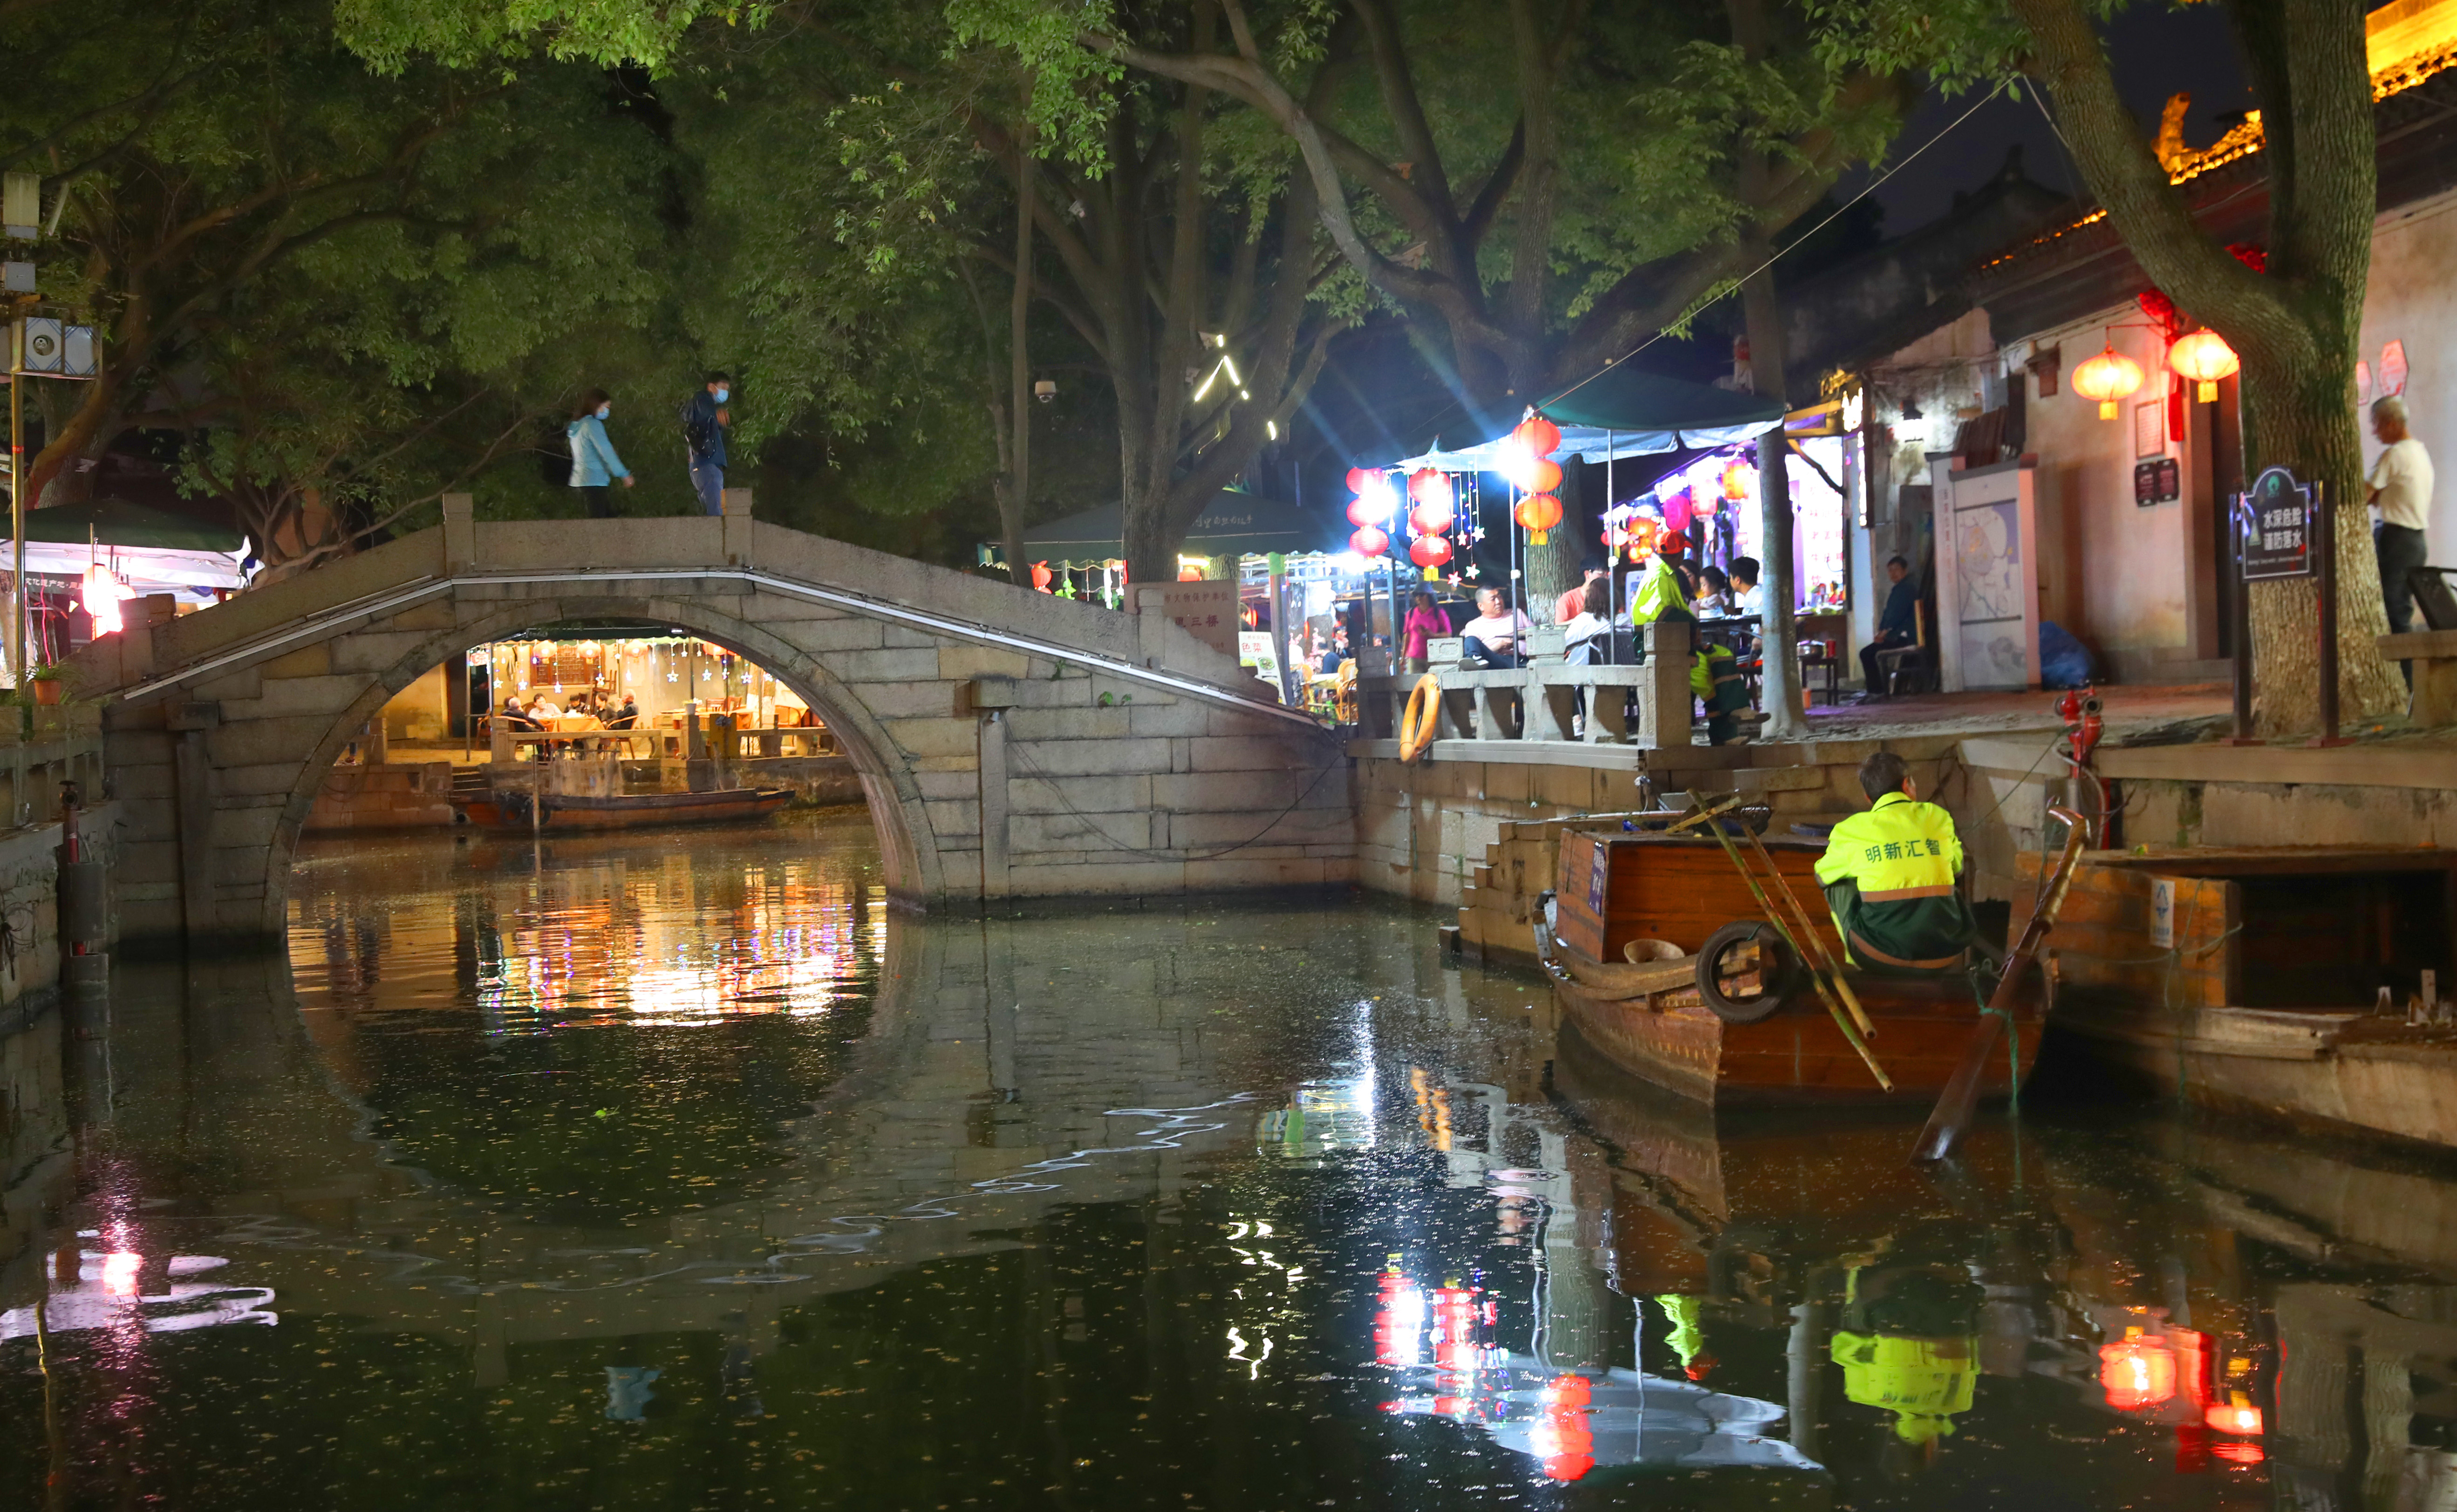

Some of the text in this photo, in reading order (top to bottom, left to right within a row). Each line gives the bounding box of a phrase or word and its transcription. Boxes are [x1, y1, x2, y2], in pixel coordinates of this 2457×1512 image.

[2263, 506, 2302, 529] 水深危险
[1865, 838, 1940, 863] 明新汇智
